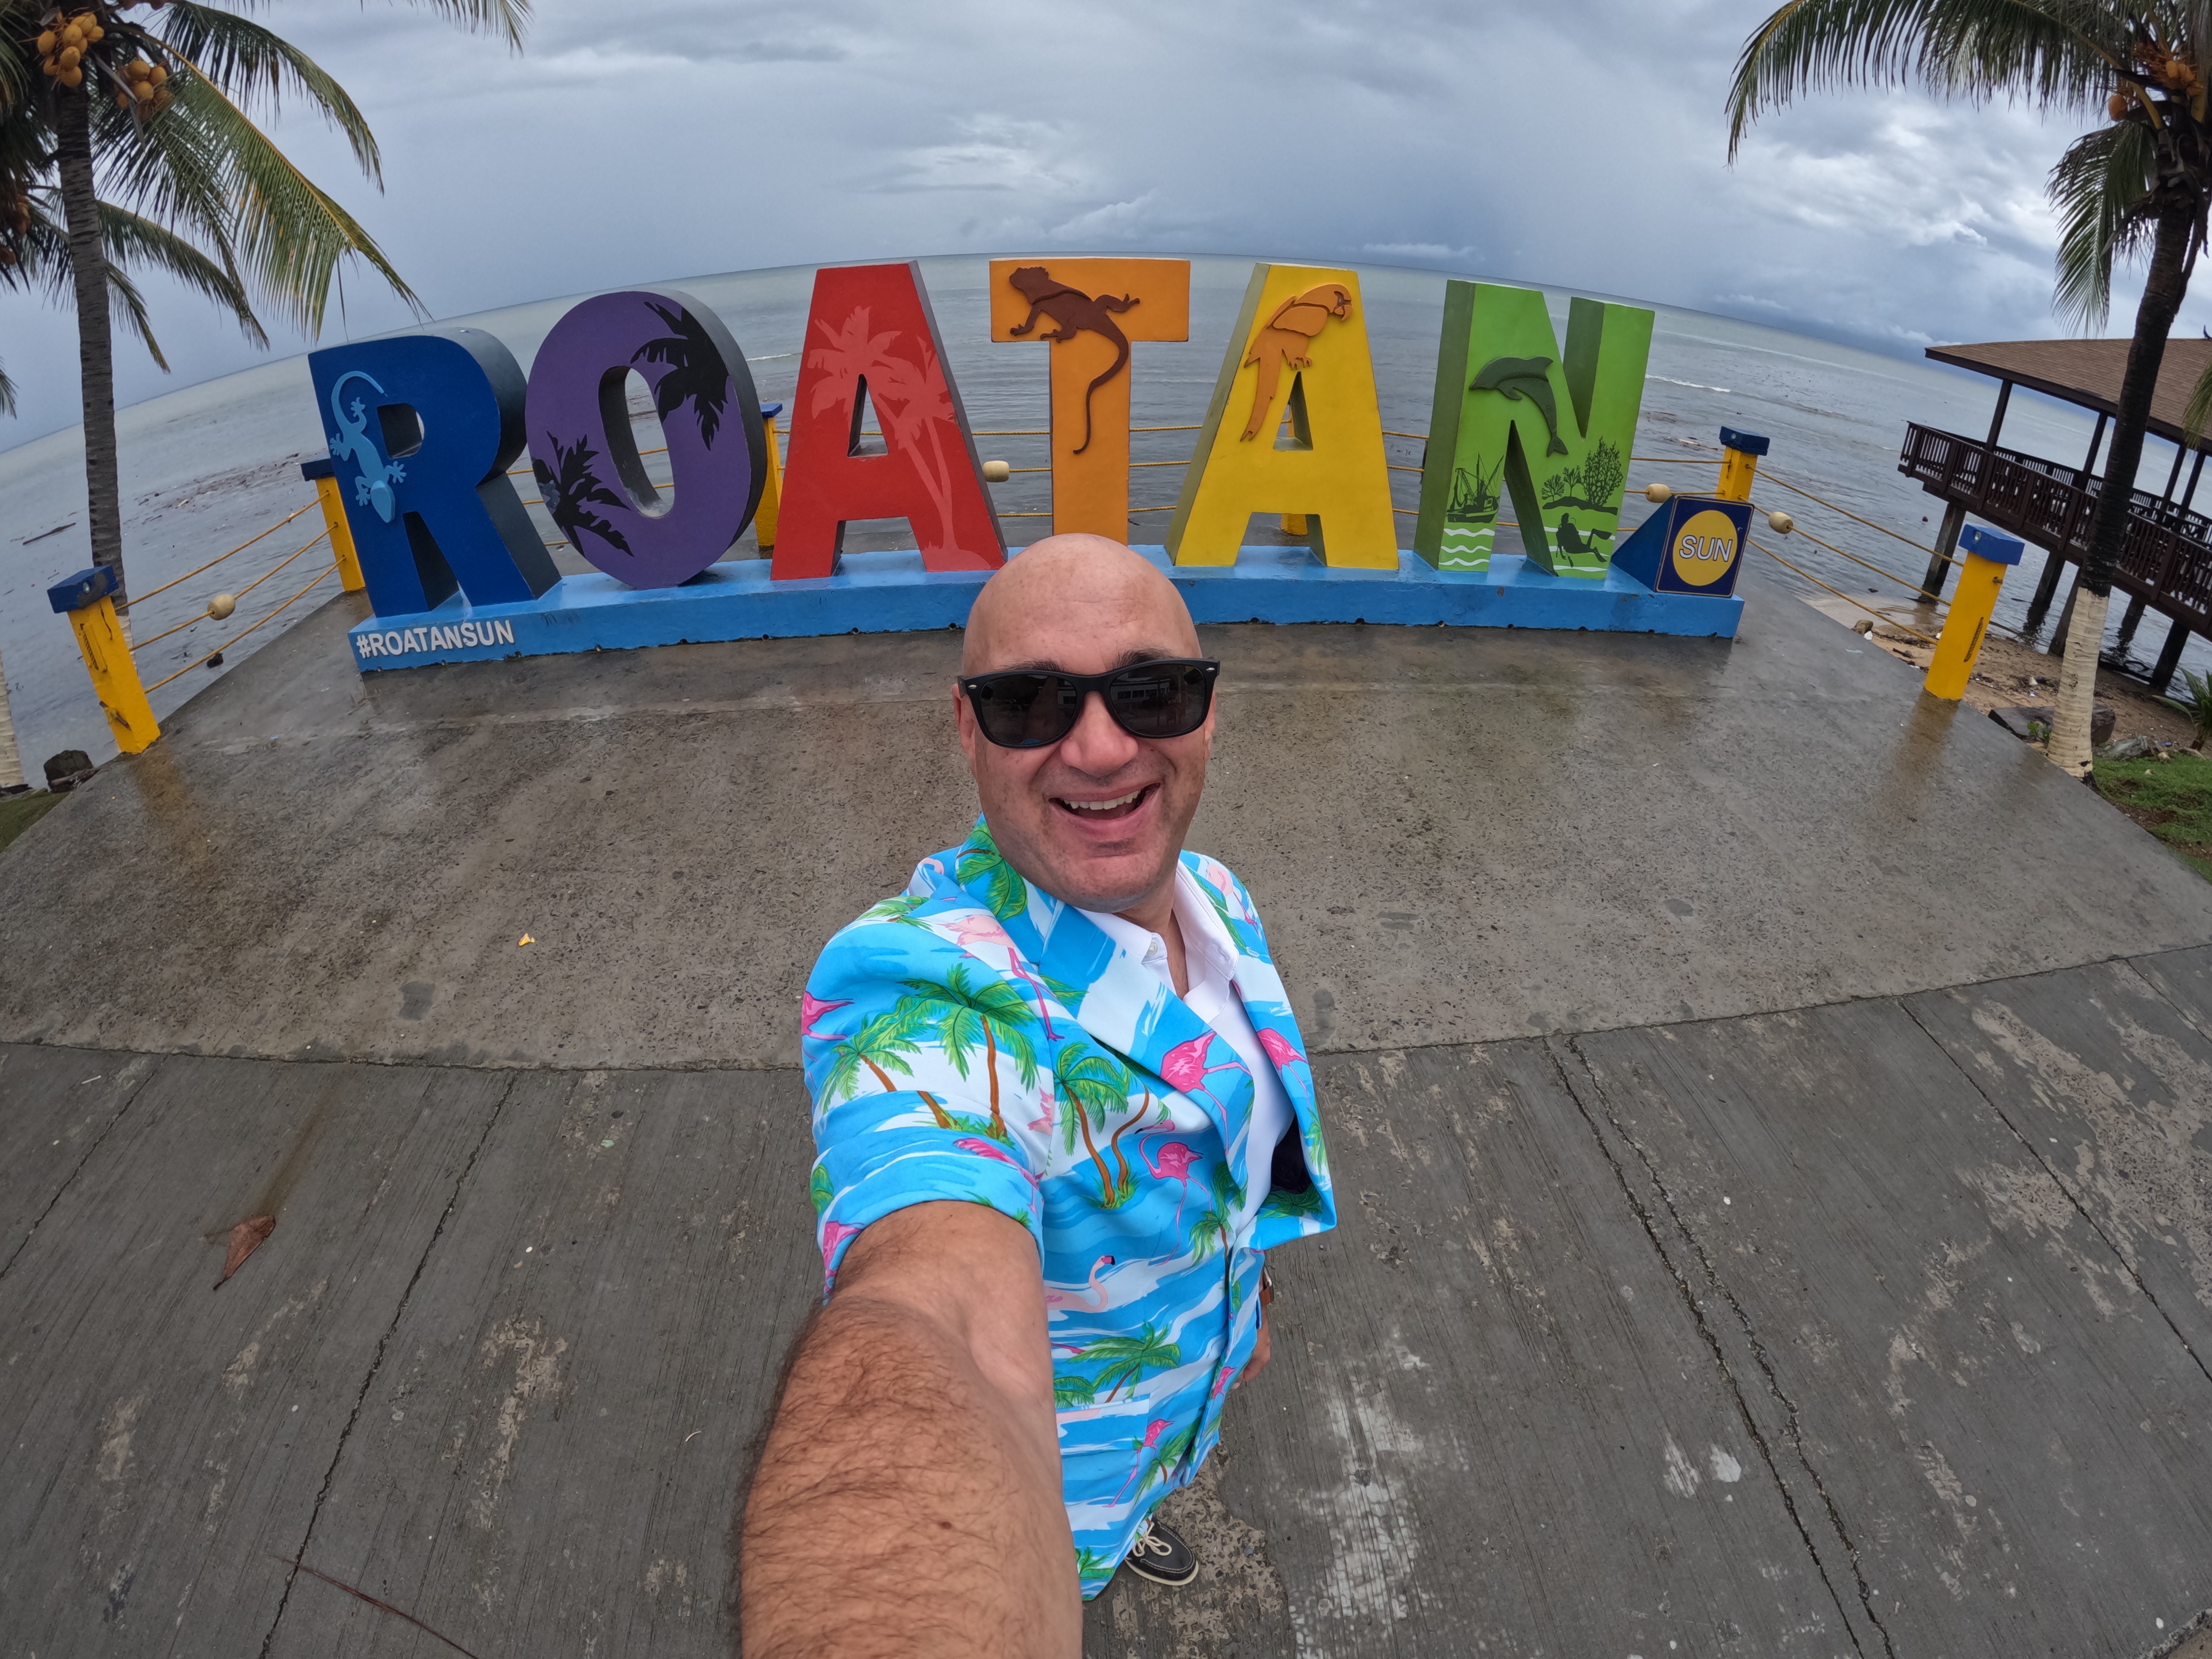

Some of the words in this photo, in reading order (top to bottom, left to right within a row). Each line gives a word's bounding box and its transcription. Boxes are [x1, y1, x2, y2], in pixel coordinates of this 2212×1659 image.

[308, 259, 1655, 618] ROATAN
[1679, 535, 1733, 562] SUN
[356, 620, 515, 659] #ROATANSUN
